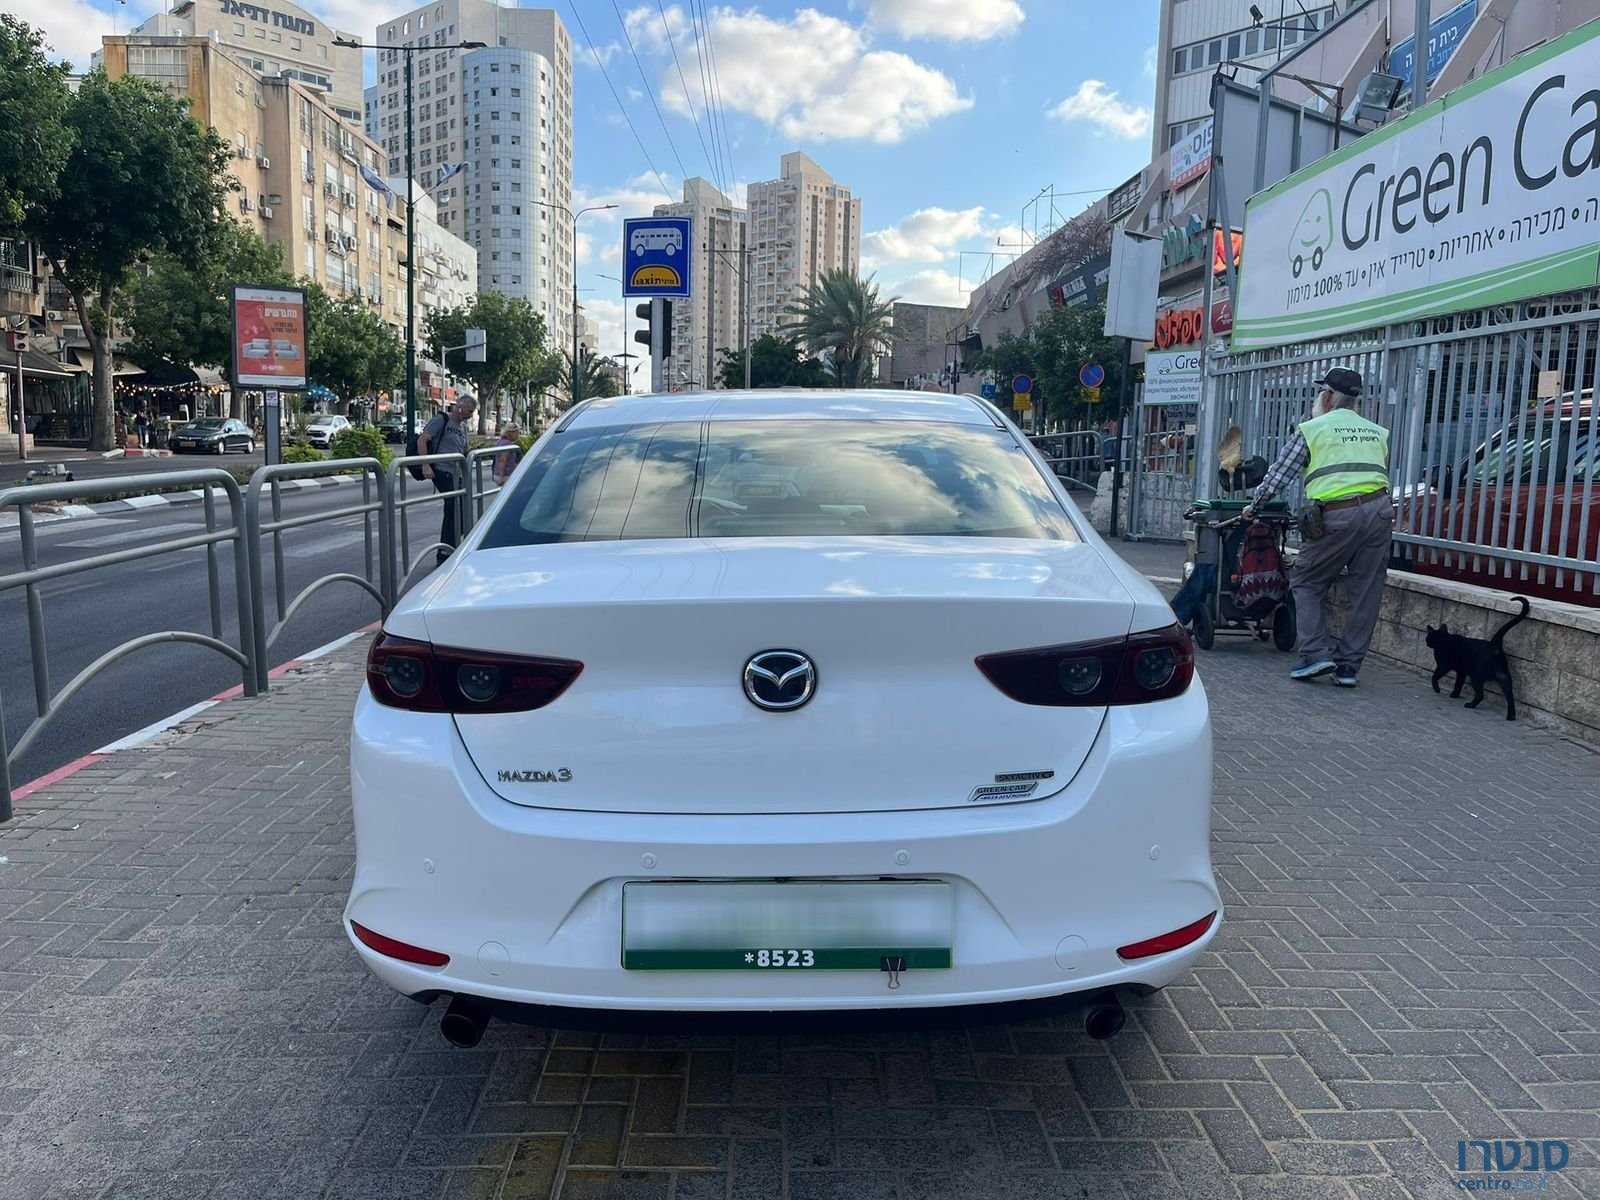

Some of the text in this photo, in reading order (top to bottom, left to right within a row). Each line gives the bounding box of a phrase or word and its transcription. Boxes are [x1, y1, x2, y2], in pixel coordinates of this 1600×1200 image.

[219, 0, 314, 36] מעוז דניאל
[1439, 26, 1458, 48] בית
[1341, 75, 1600, 252] Green Ca
[1287, 198, 1599, 311] ה מכירה אחריות טרייד אין עד 100% מימון
[1175, 355, 1200, 370] Gre
[977, 784, 1027, 794] GREEN CAR
